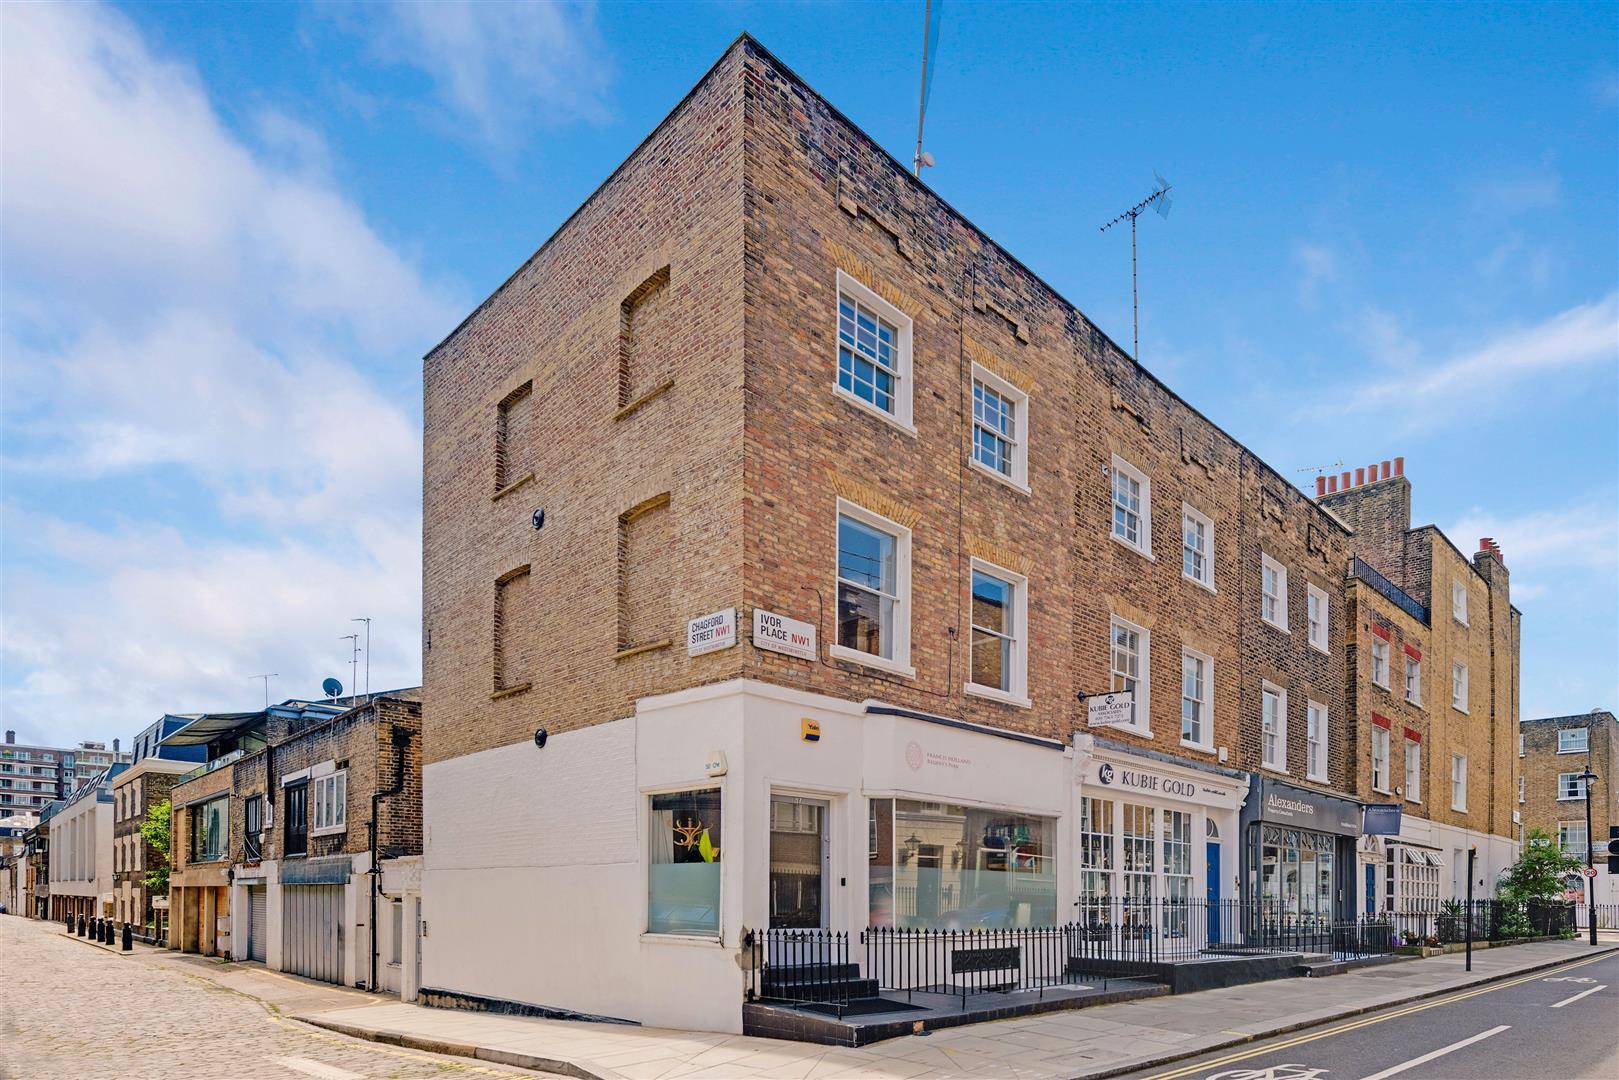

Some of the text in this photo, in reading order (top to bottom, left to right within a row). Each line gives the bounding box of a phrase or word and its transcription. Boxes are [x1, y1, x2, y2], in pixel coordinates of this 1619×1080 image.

[691, 614, 724, 633] CHAGFORD
[760, 614, 782, 628] IVOR
[691, 624, 730, 644] STREET NW1
[760, 625, 810, 647] PLACE NW1
[1089, 702, 1130, 713] KUBIE GOLD
[1101, 765, 1114, 783] kg
[1122, 771, 1159, 791] KUBIE
[1162, 779, 1196, 798] GOLD
[1268, 793, 1314, 815] Alexanders
